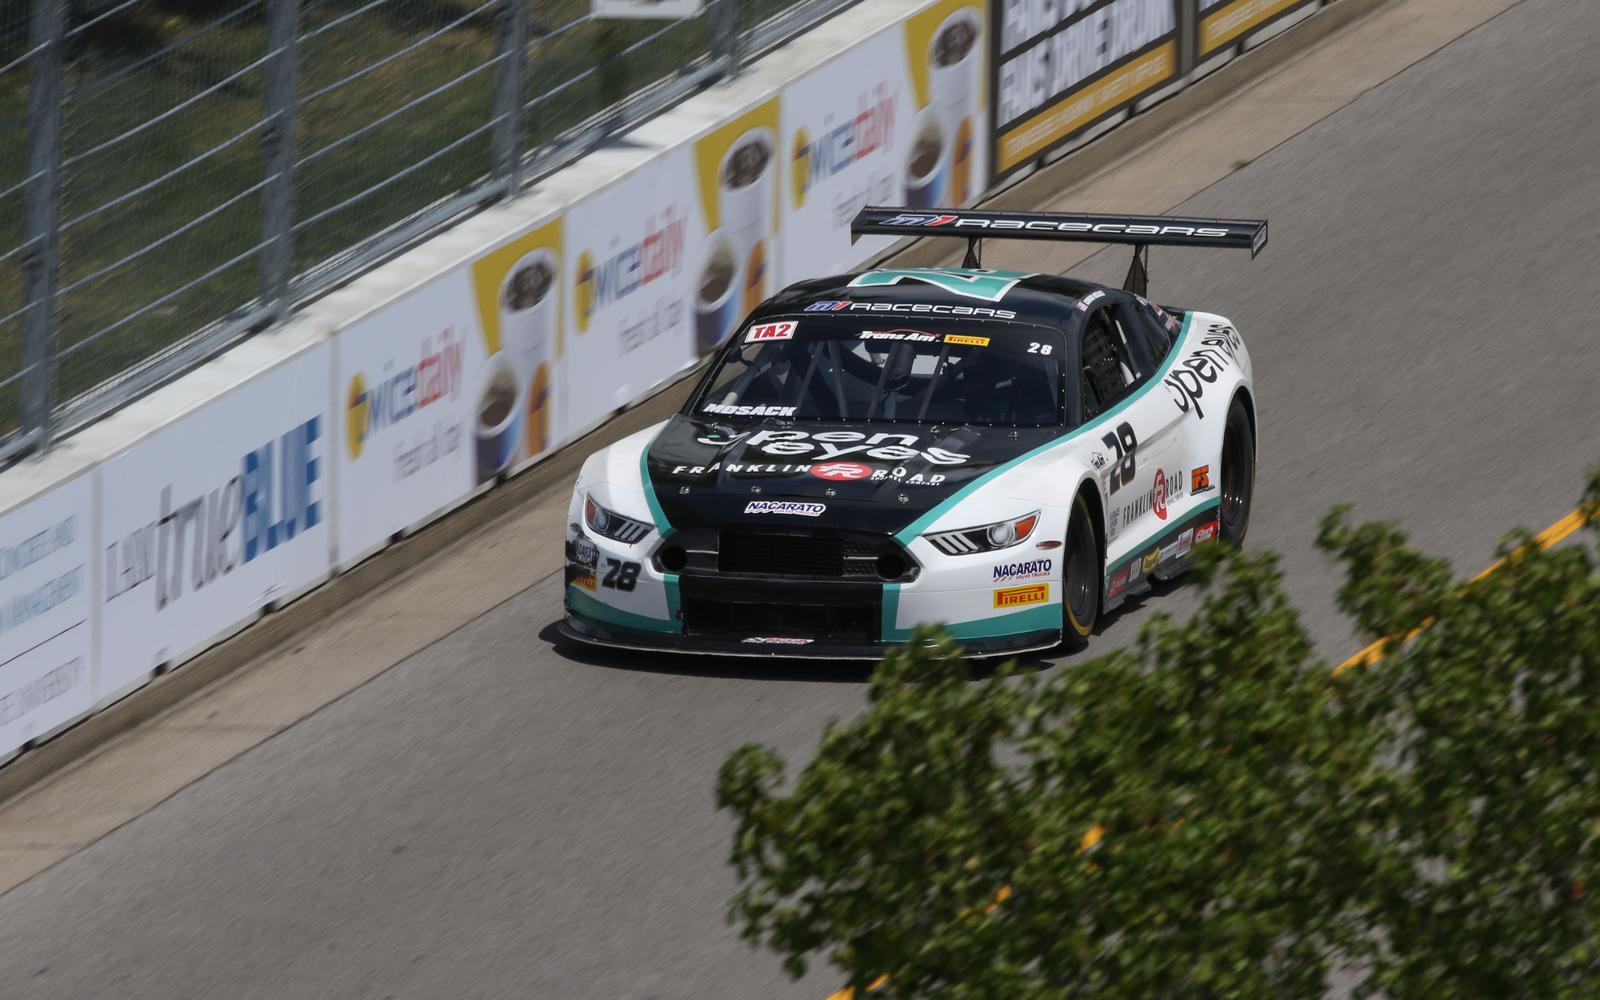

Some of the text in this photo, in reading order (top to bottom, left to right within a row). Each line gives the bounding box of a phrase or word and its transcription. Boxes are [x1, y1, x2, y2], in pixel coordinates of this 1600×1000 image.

[754, 324, 791, 338] TA2
[949, 336, 985, 345] PIRELLI
[1028, 343, 1053, 355] 28
[1102, 421, 1137, 496] 28
[672, 462, 812, 474] FRANKLIN
[872, 467, 946, 483] ROAD
[748, 502, 824, 512] NACARATO
[1123, 489, 1153, 527] FRANKLIN
[1166, 470, 1183, 499] ROAD
[602, 557, 641, 592] 28
[993, 559, 1052, 578] NACARATO
[997, 586, 1045, 605] PIRELLI
